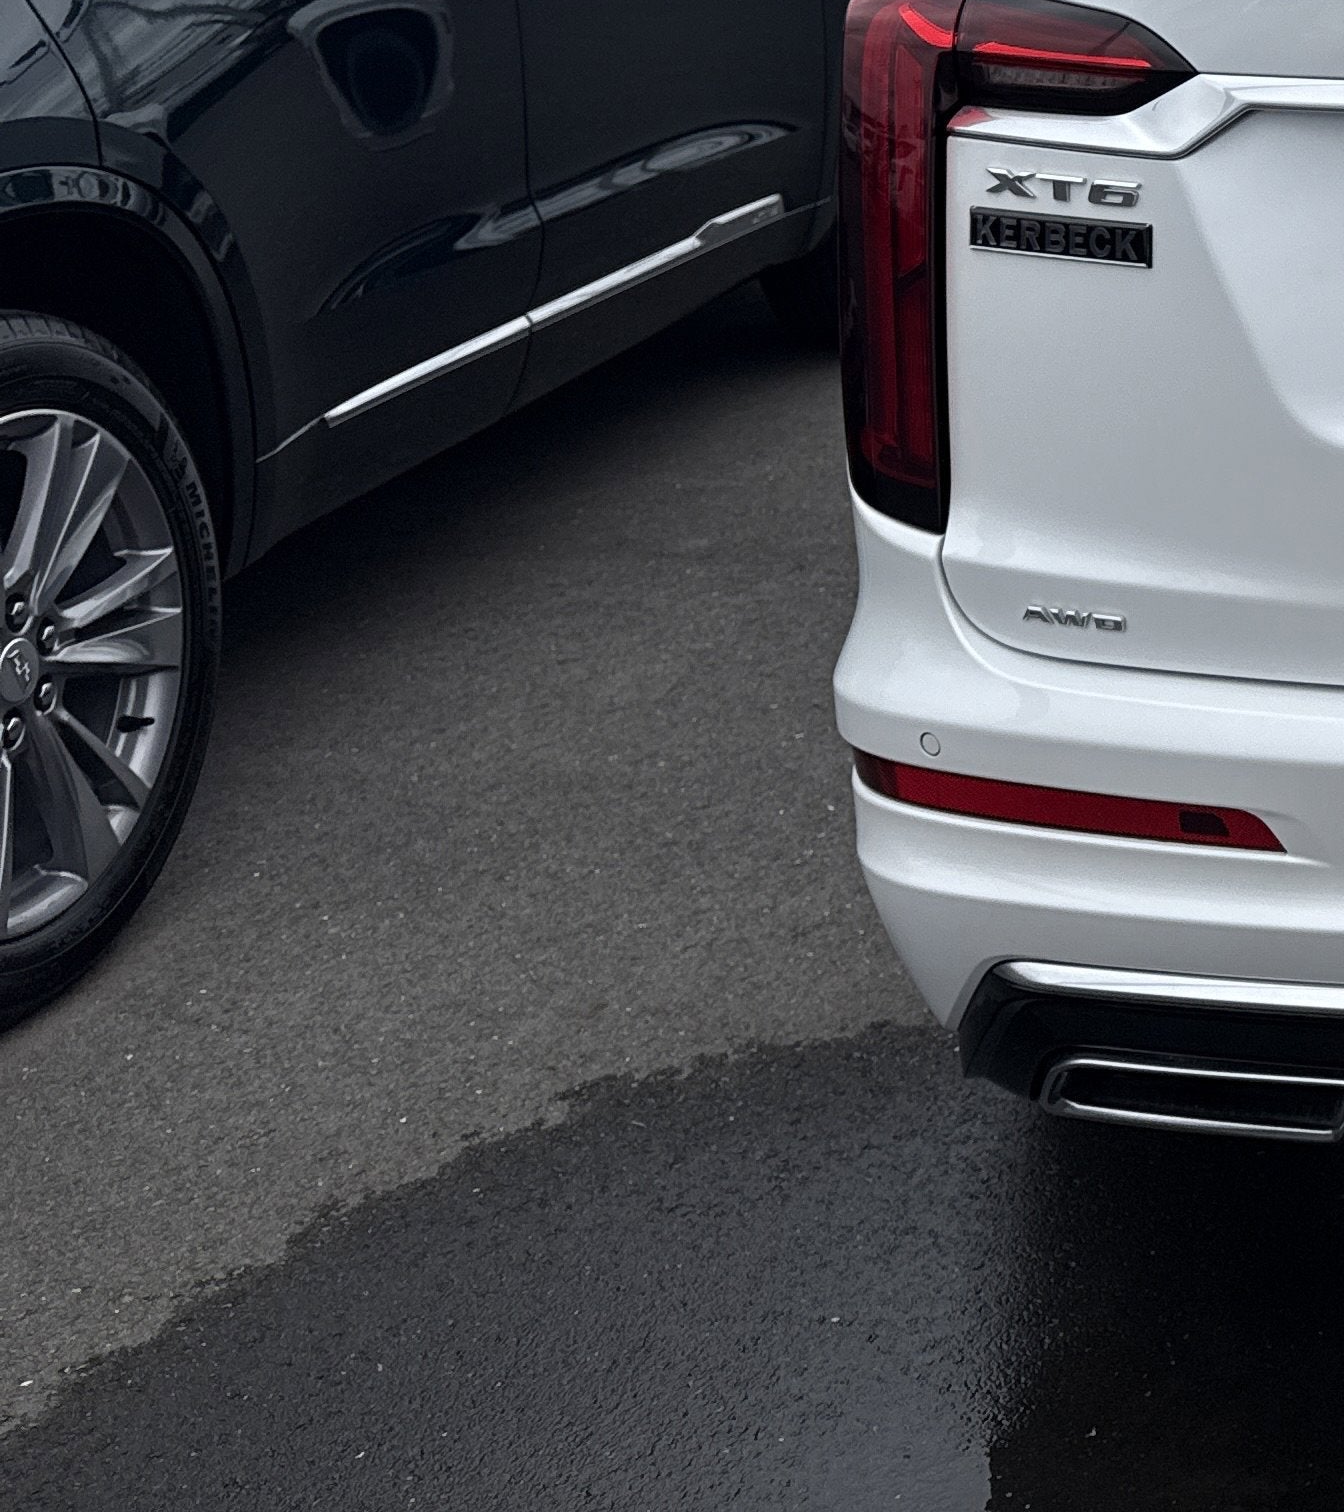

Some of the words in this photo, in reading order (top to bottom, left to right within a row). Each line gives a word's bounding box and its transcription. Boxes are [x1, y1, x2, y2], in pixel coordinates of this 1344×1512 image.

[985, 166, 1143, 208] XT6
[975, 214, 1139, 261] KERBECK
[1022, 605, 1128, 633] AWD
